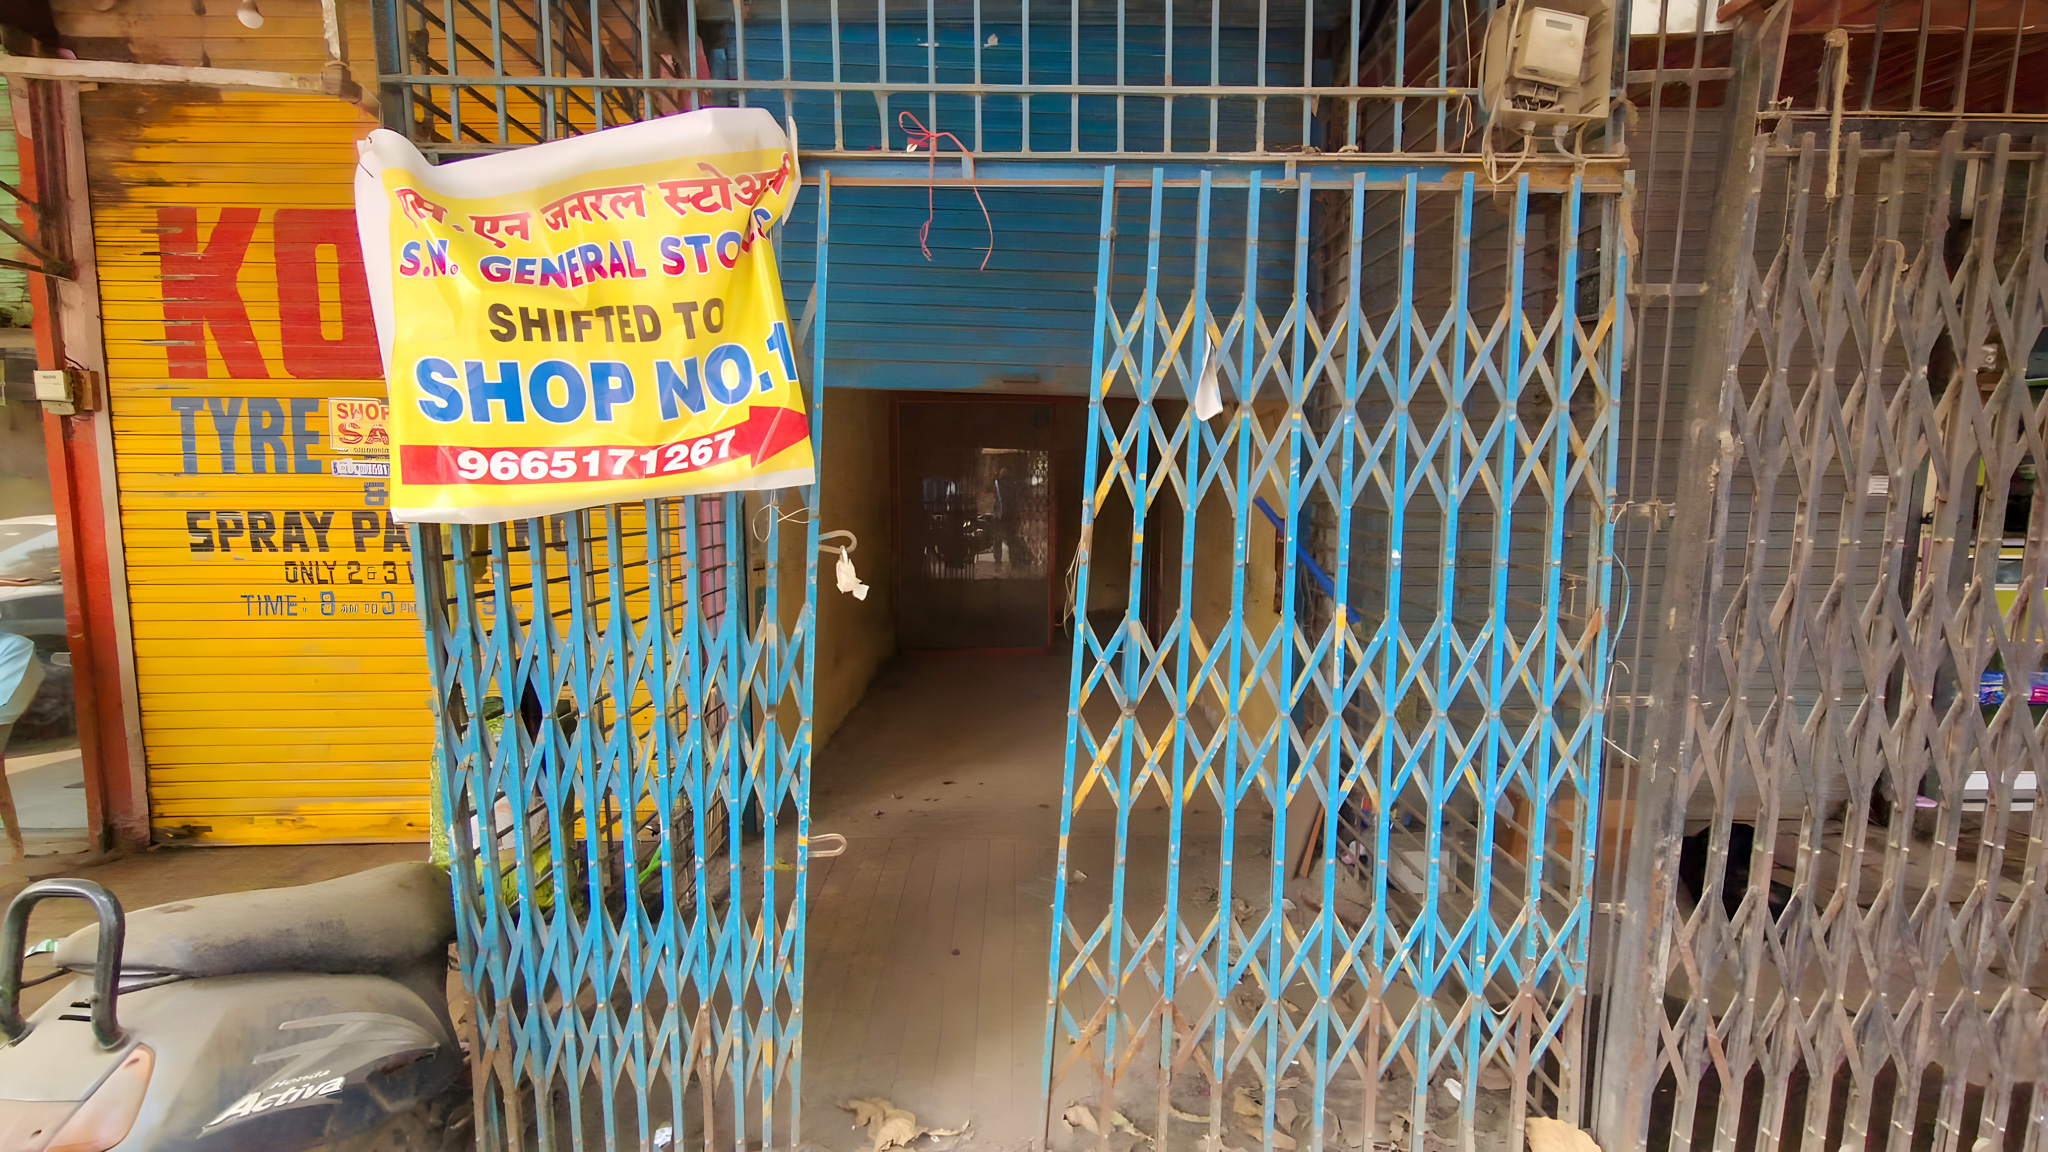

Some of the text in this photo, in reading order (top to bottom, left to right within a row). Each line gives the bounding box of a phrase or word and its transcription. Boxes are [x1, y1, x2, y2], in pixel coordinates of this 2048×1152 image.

[540, 185, 646, 231] जनरल
[480, 240, 646, 288] GENERAL
[490, 298, 724, 342] SHIFTED TO
[416, 322, 796, 423] SHOP NO.1
[171, 397, 320, 474] TYRE
[458, 429, 735, 480] 9665171267
[187, 512, 334, 552] SPRAY
[284, 561, 336, 585] ONLY
[202, 1076, 346, 1129] Activa
